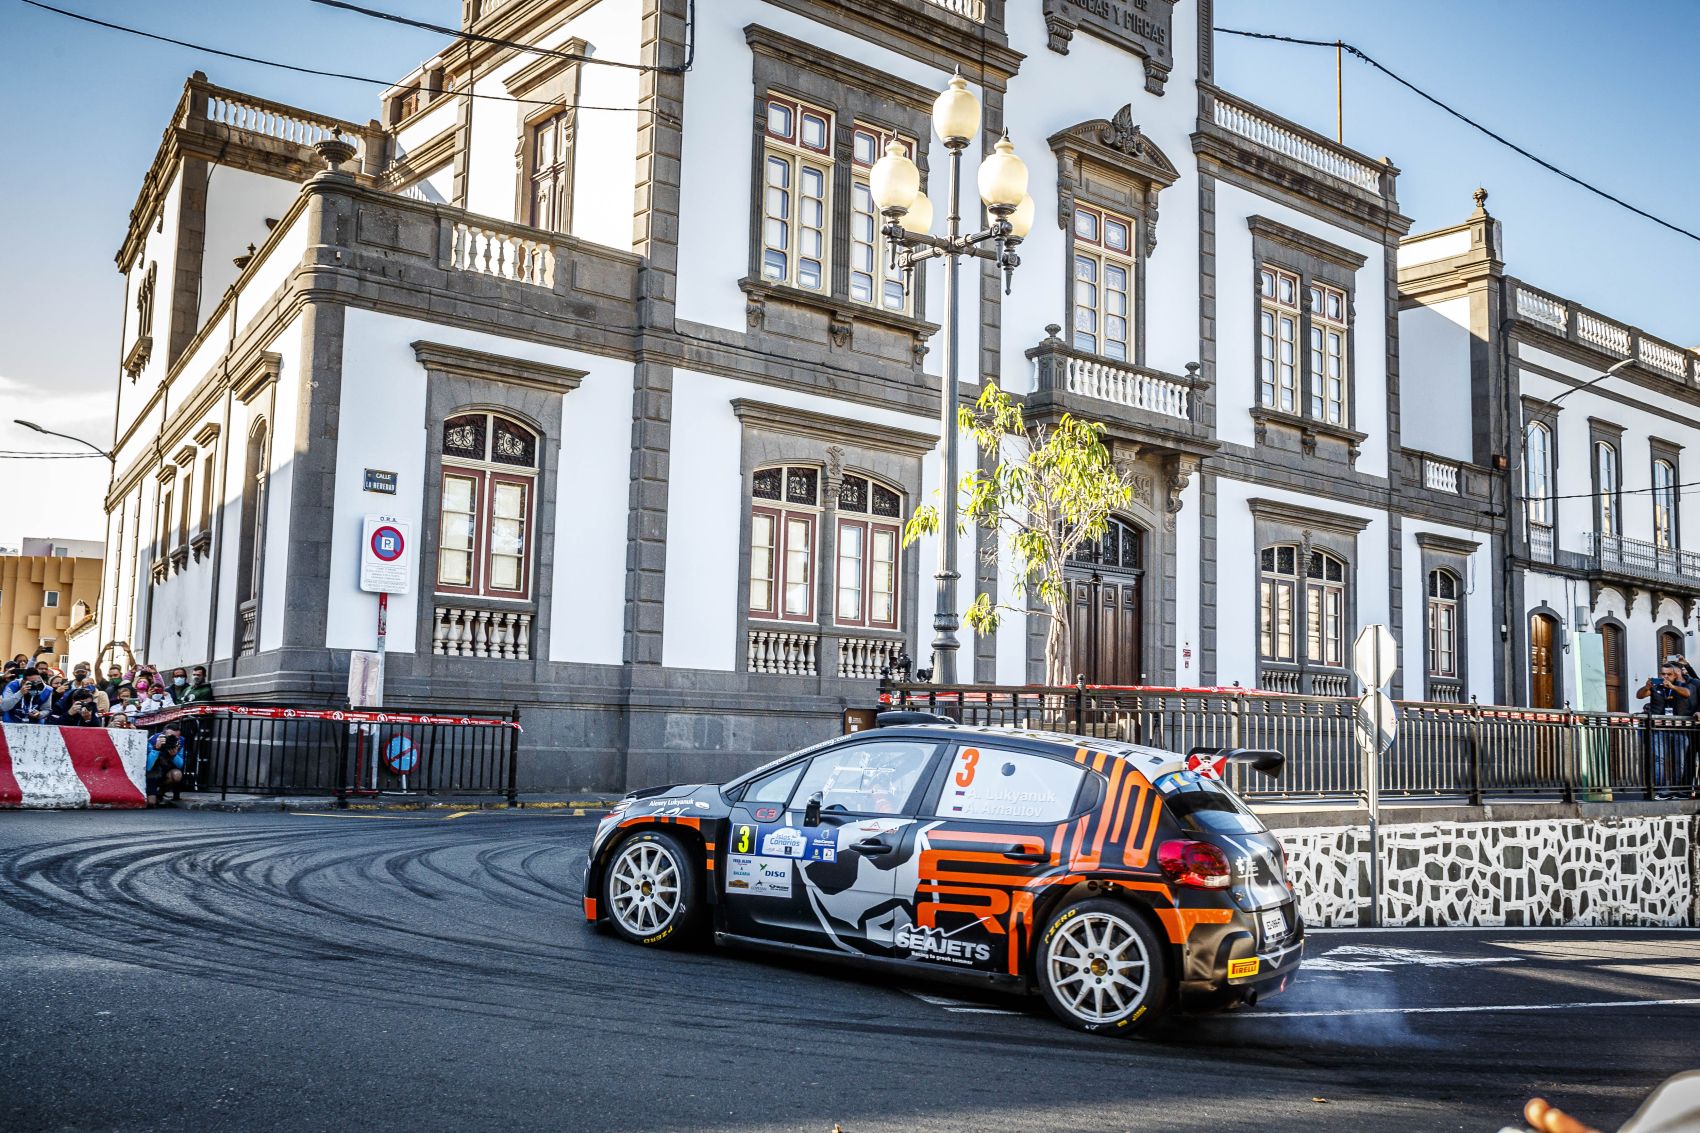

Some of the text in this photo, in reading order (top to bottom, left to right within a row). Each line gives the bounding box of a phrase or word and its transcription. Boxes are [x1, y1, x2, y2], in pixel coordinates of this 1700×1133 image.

[1124, 11, 1165, 46] FIRGAS
[955, 748, 980, 788] 3
[985, 786, 1056, 805] Lukyanuk
[756, 808, 777, 819] C3
[983, 803, 1042, 817] Arnautov
[738, 825, 751, 853] 3
[770, 837, 800, 847] Canarias
[895, 931, 990, 961] SEAJETS
[1231, 960, 1257, 975] PIRELLI
